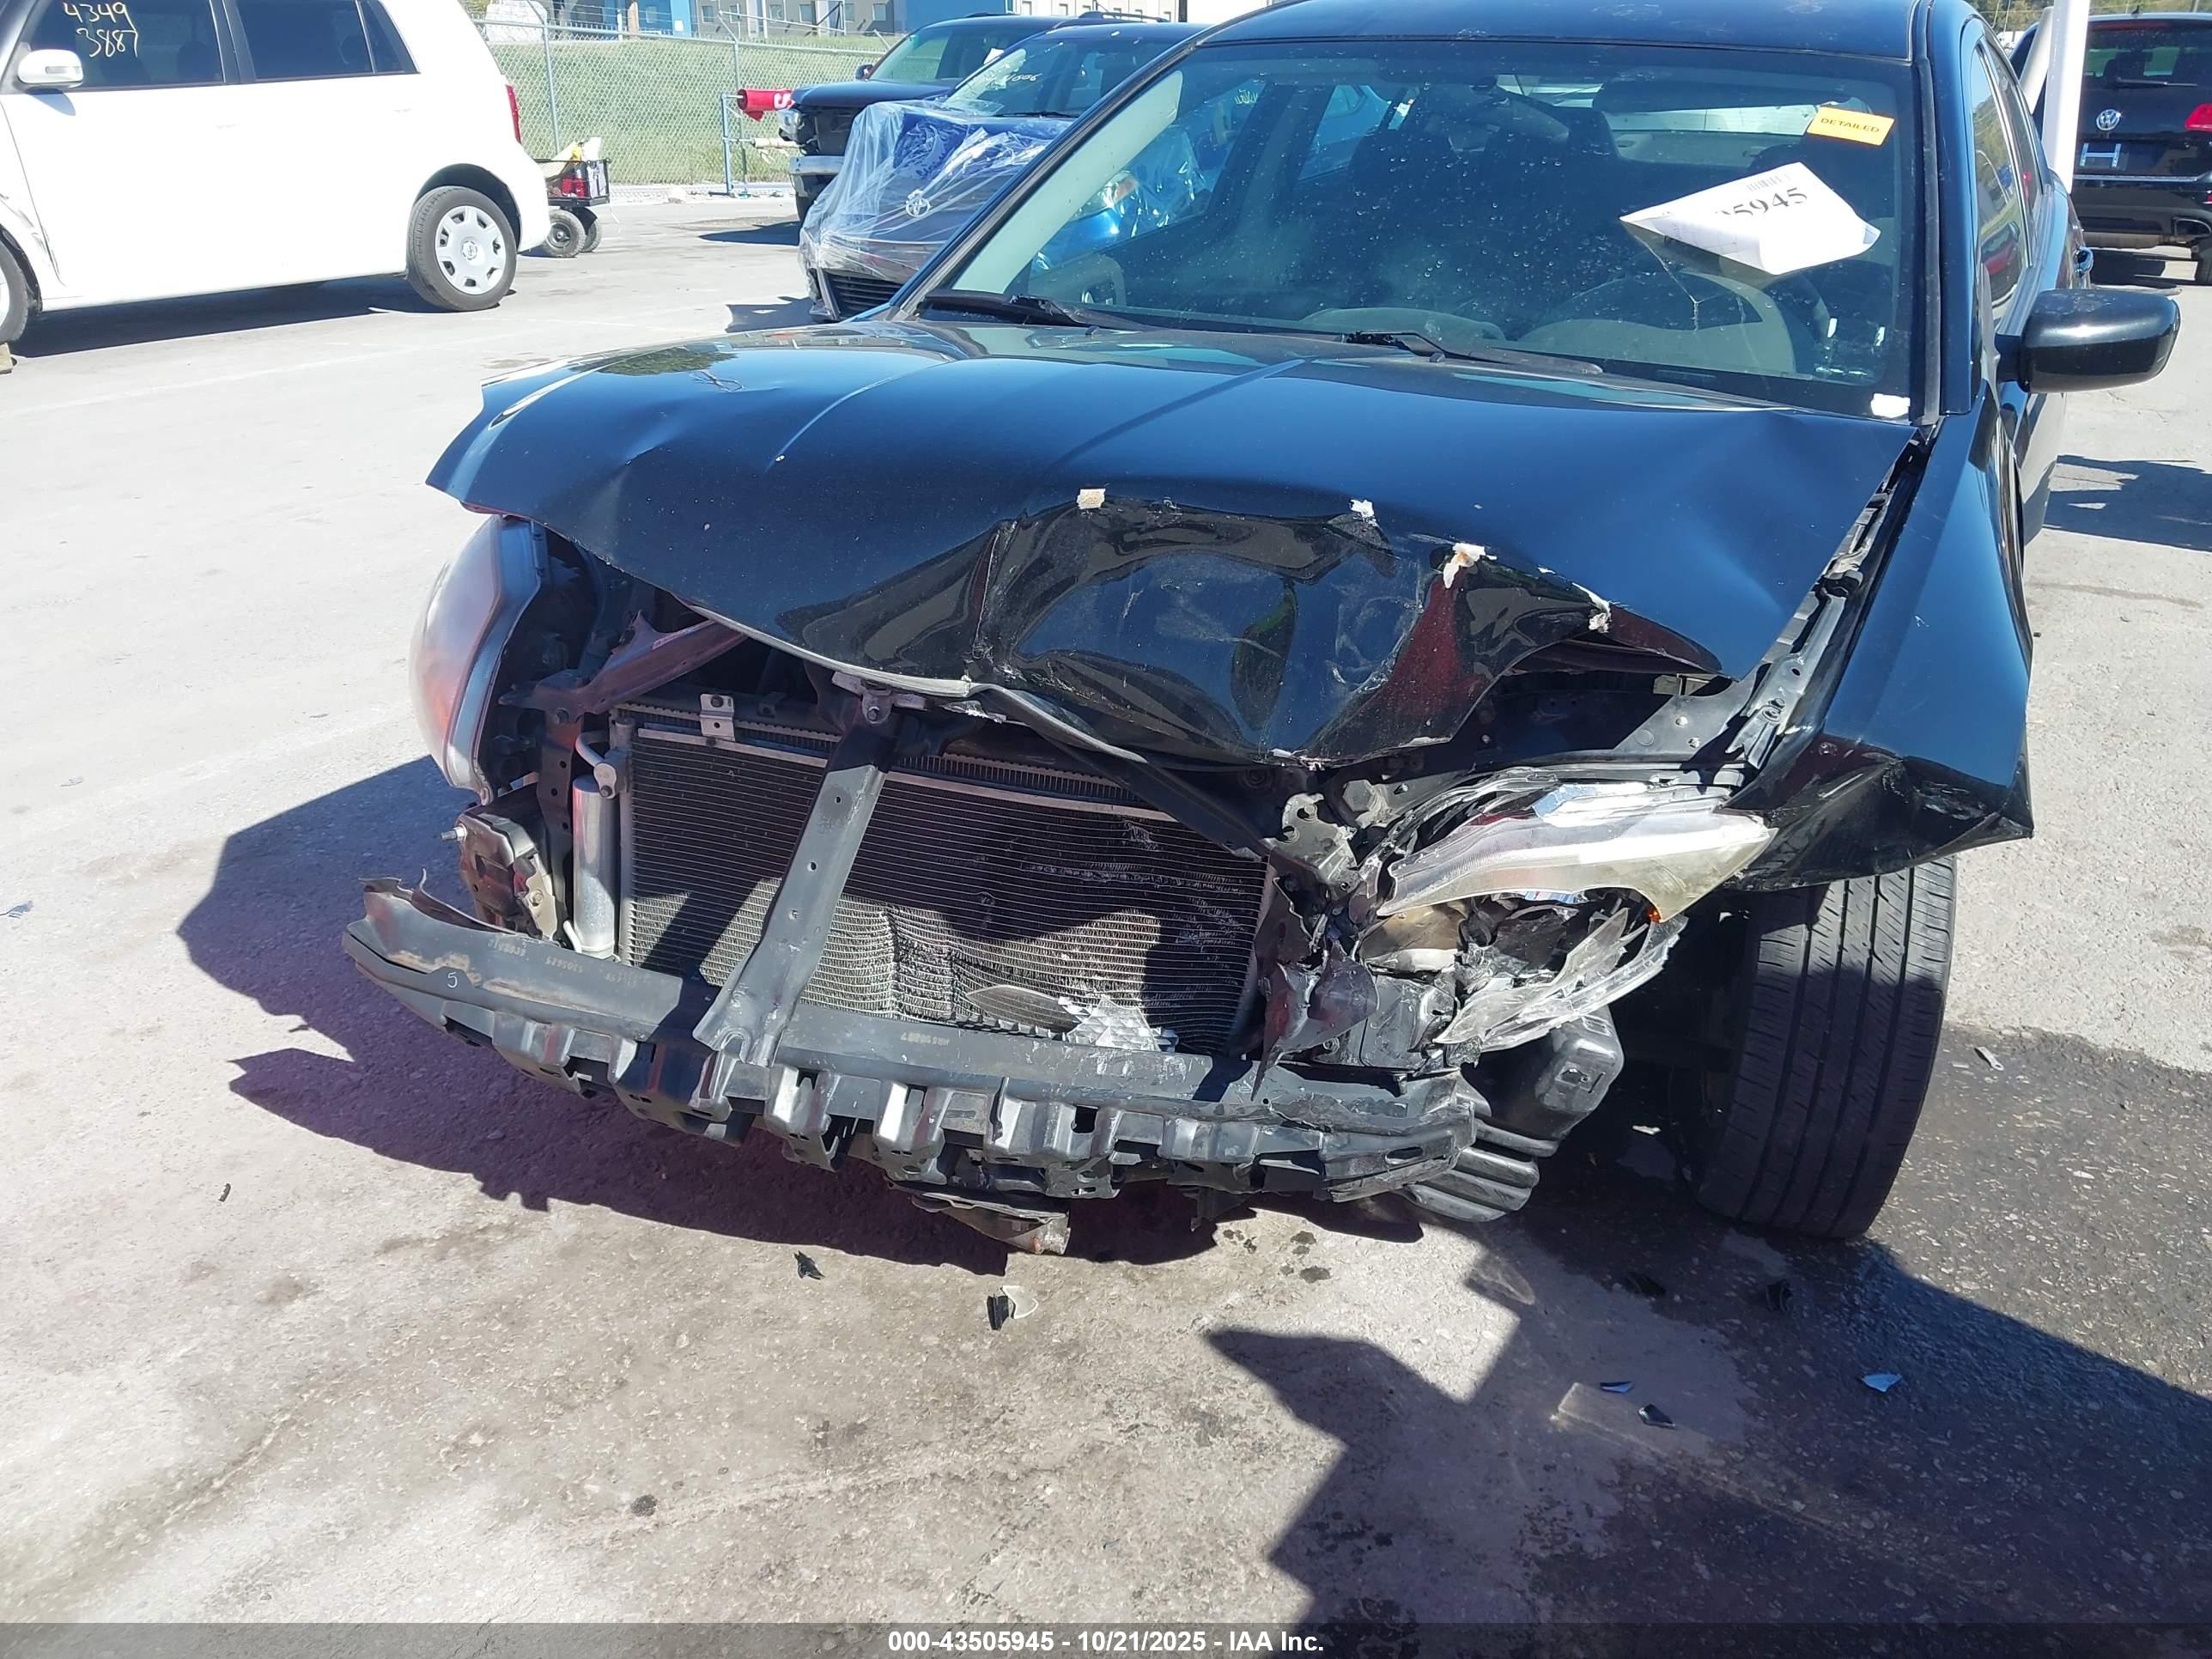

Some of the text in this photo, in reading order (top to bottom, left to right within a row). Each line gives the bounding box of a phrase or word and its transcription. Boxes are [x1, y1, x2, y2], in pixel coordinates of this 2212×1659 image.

[63, 2, 137, 32] 4349
[76, 27, 138, 58] 3887
[1820, 117, 1881, 133] DETAILED
[1720, 187, 1808, 216] 5945
[447, 971, 458, 988] 5
